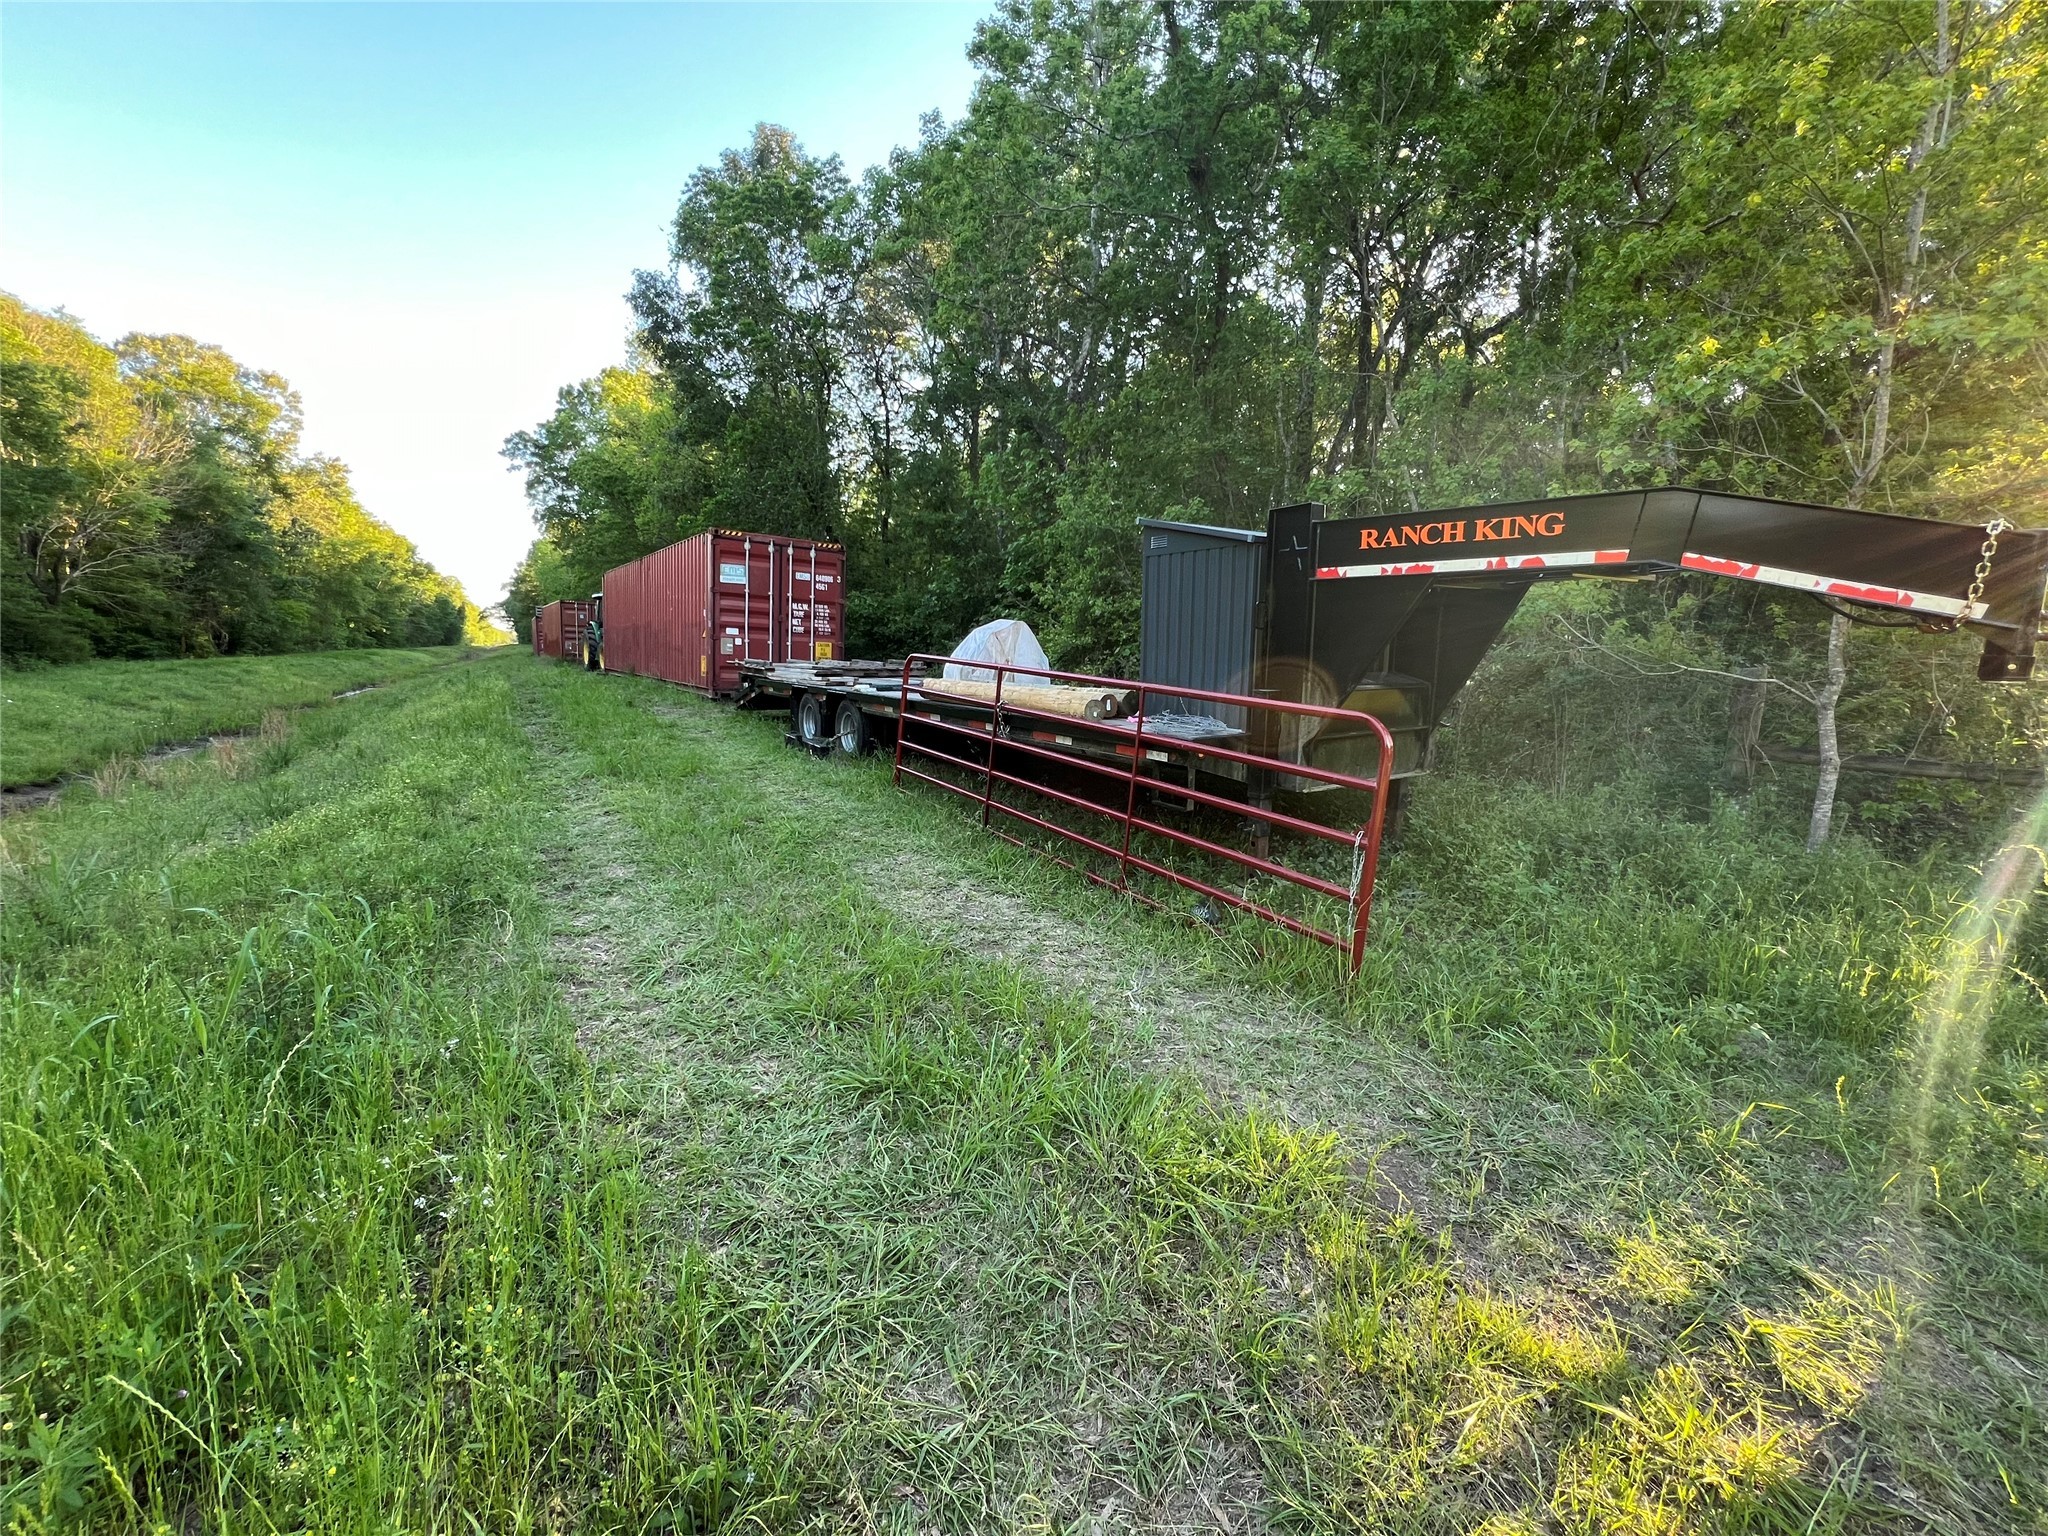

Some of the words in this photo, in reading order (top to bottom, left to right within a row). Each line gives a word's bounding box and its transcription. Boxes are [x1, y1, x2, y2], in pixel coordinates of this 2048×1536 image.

[1359, 520, 1467, 550] RANCH
[1473, 512, 1566, 542] KING
[836, 575, 842, 584] 3
